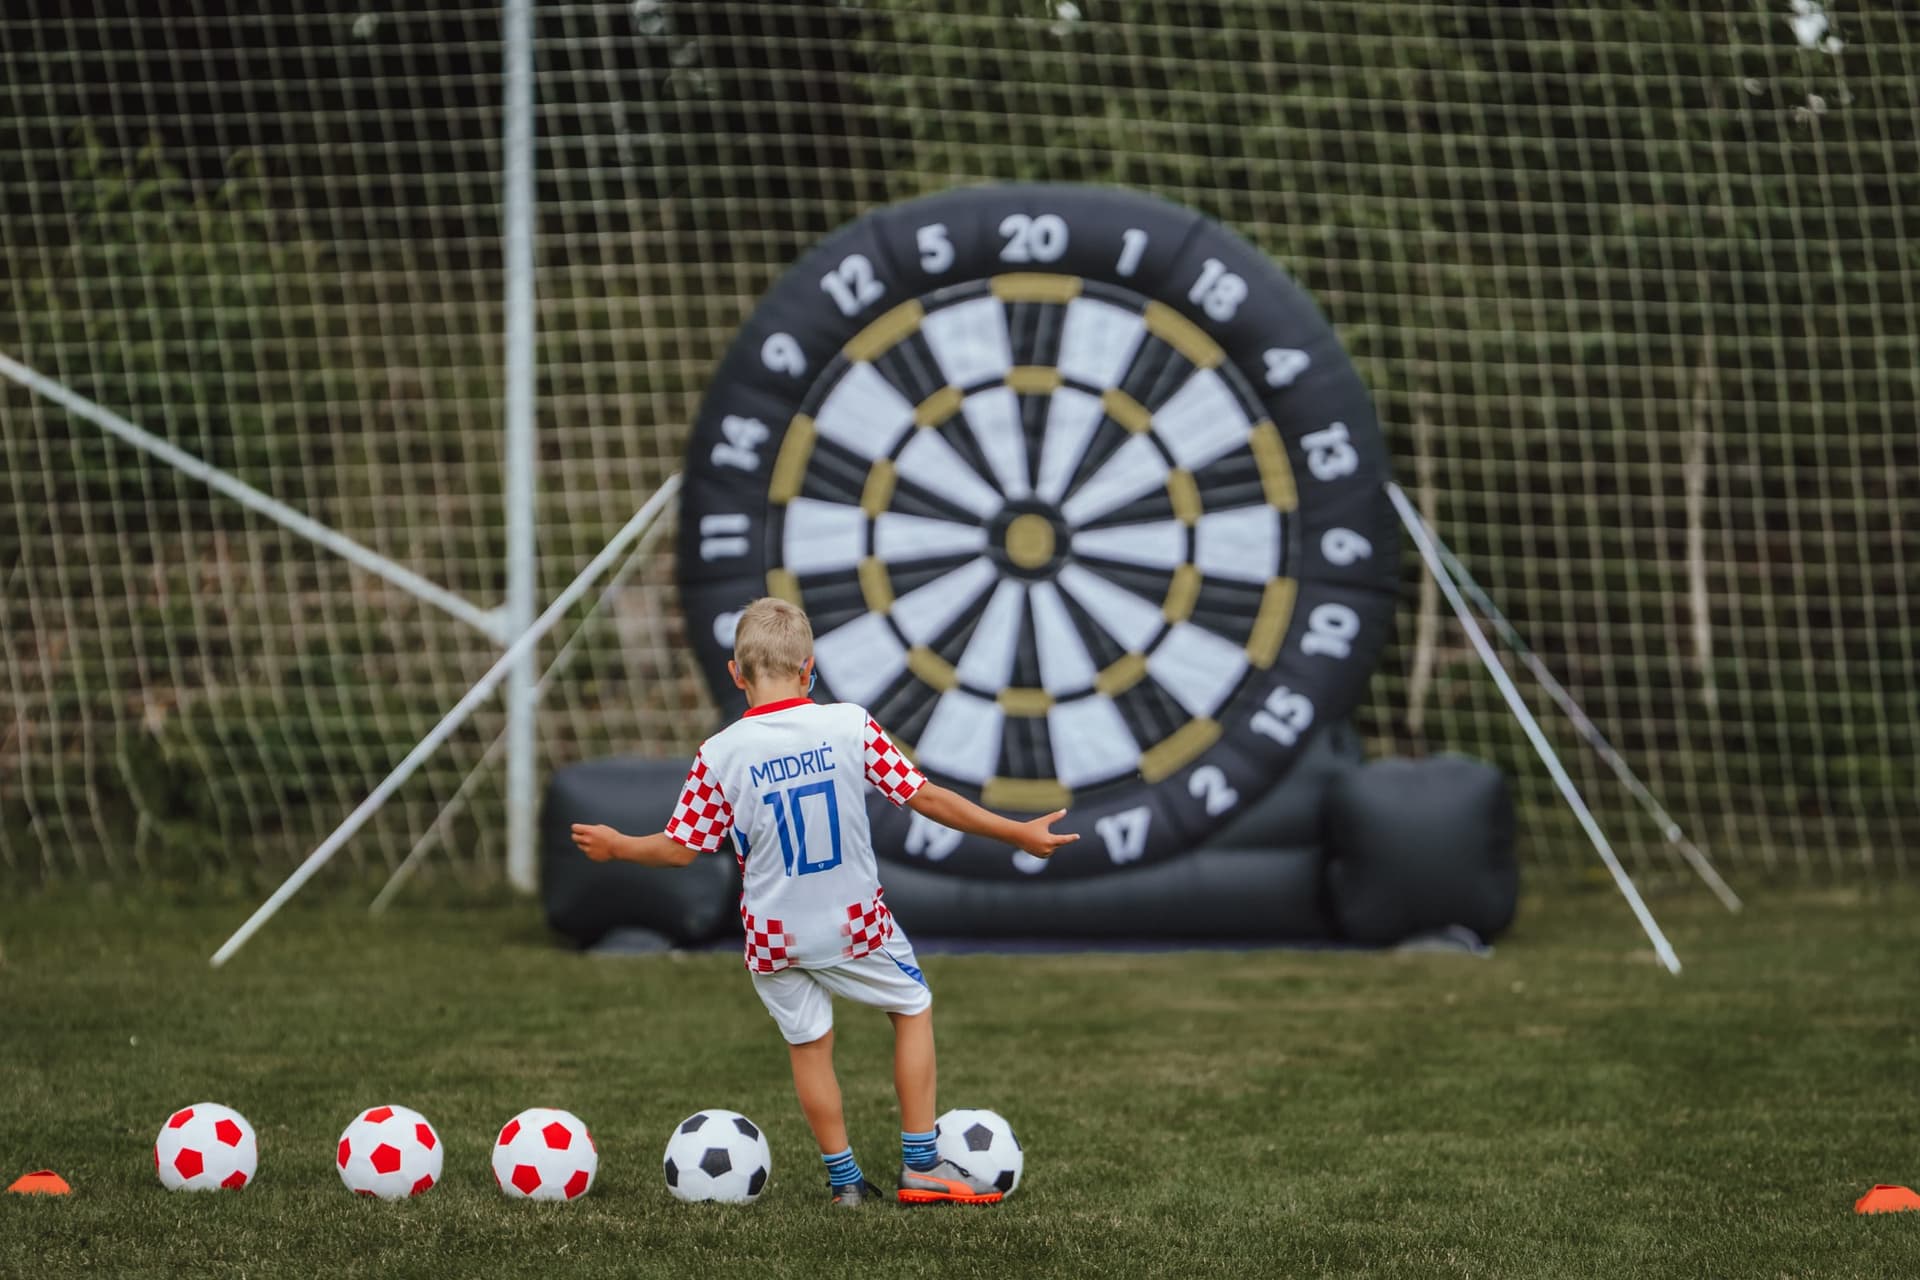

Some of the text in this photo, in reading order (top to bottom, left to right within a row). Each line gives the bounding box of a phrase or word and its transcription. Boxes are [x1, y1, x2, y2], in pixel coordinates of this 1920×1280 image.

[915, 222, 954, 273] 5
[998, 213, 1068, 262] 20
[1116, 228, 1148, 276] 1
[820, 253, 885, 316] 12
[1188, 257, 1249, 321] 18
[760, 332, 807, 376] 9
[1262, 348, 1311, 387] 4
[711, 415, 769, 470] 14
[1300, 421, 1358, 481] 13
[700, 513, 750, 558] 11
[1321, 527, 1371, 565] 6
[1300, 603, 1359, 658] 10
[1249, 685, 1313, 745] 15
[749, 742, 836, 788] MODRIĆ
[1188, 765, 1237, 816] 2
[763, 779, 842, 877] 10
[1094, 805, 1152, 864] 17
